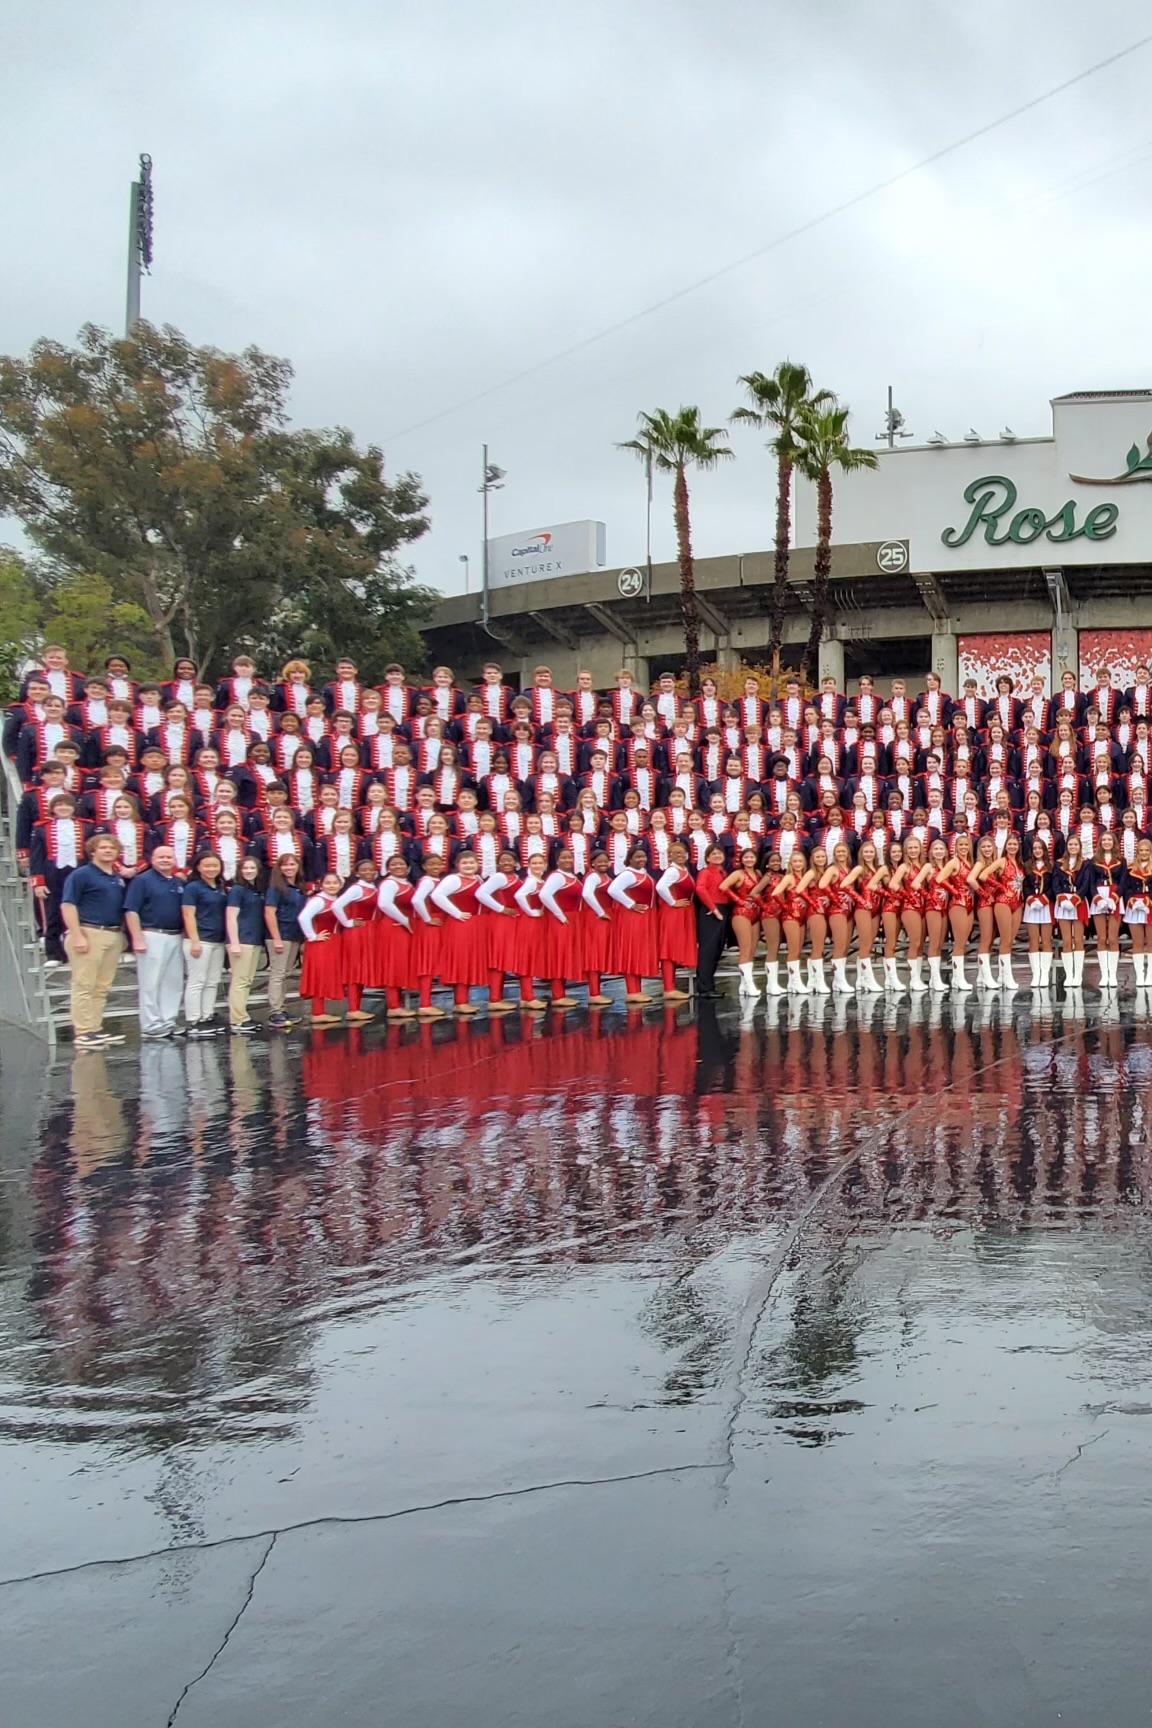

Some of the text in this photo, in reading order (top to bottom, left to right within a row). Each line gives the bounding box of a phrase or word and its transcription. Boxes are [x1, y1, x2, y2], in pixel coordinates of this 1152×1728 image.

[941, 475, 1119, 547] Rose
[881, 547, 904, 566] 25
[504, 561, 563, 578] VENTURE X
[621, 573, 640, 590] 24
